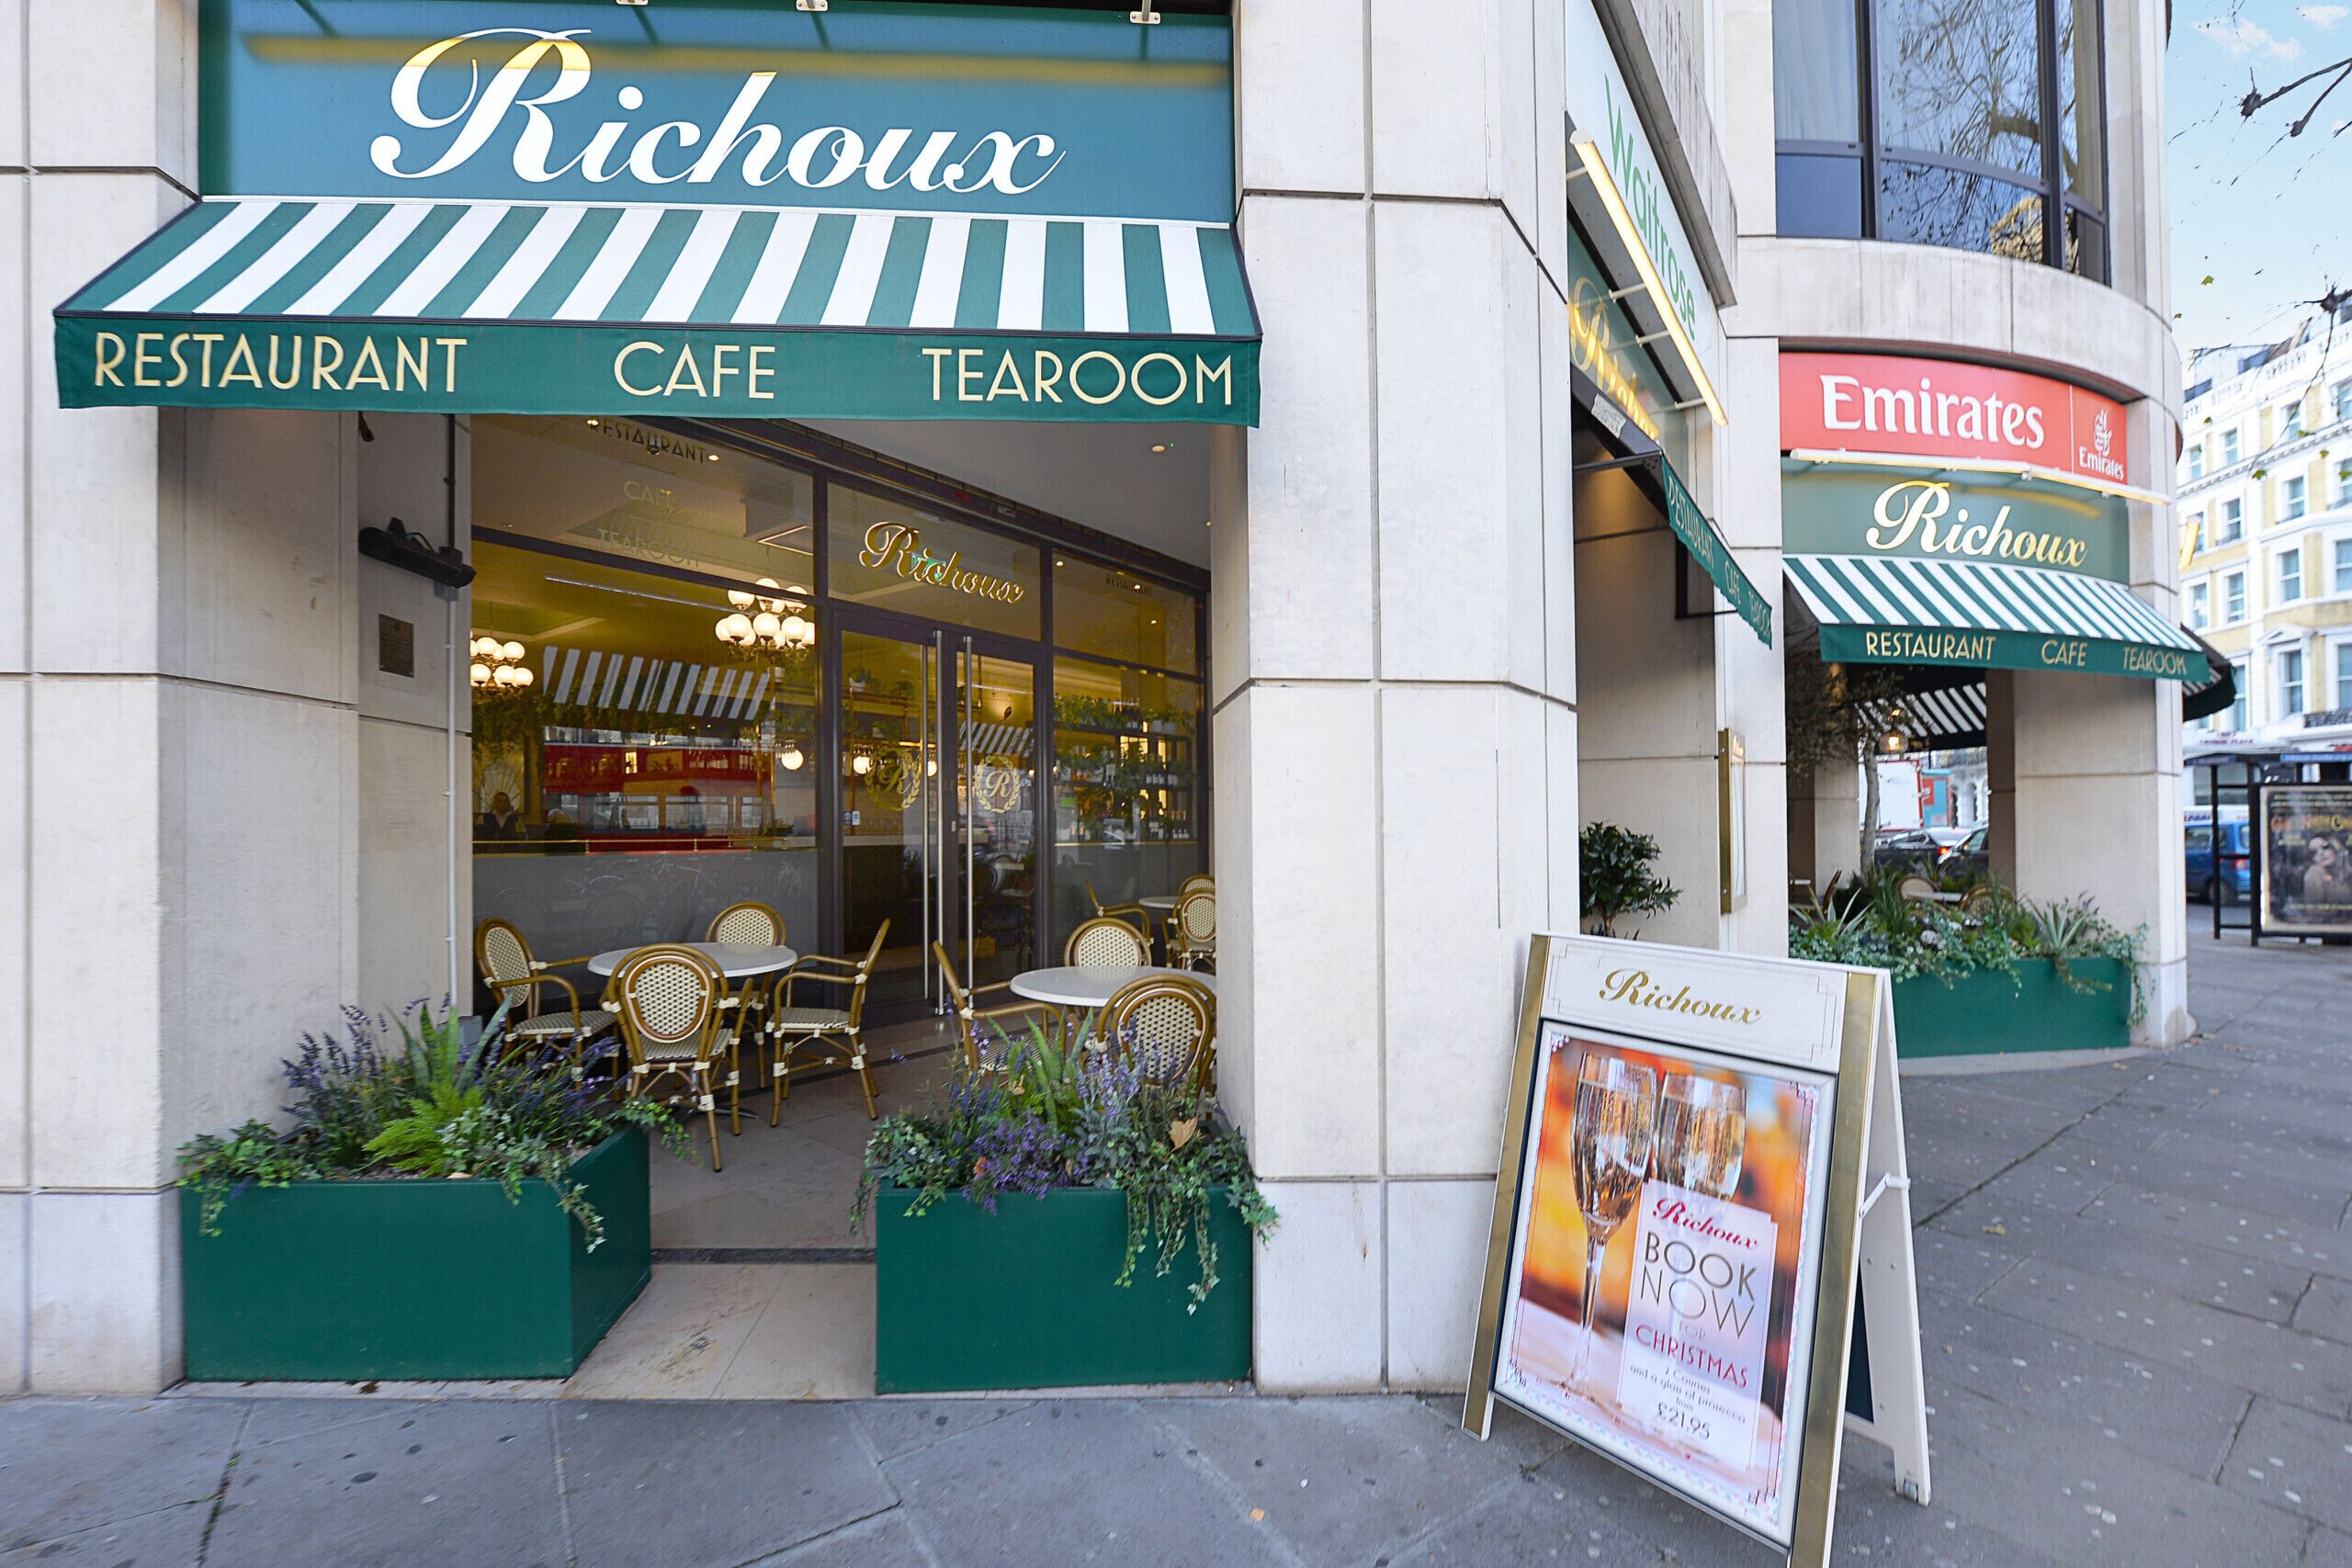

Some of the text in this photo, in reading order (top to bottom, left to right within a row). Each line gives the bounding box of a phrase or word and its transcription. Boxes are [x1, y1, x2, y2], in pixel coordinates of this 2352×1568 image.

[370, 28, 1066, 195] Richoux
[1603, 73, 1697, 342] Waitrose
[95, 332, 1232, 406] RESTAURANT CAFE TEAROOM
[589, 417, 707, 464] RESTAURANT
[1820, 375, 2044, 448] Emirates
[2078, 446, 2125, 480] Emirates
[623, 480, 677, 505] CAFE
[1668, 475, 1715, 570] RESTAURANT
[1724, 559, 1742, 605] CAFE
[1865, 480, 2087, 568] Richoux
[858, 521, 1024, 604] Richoux
[1866, 631, 2188, 675] RESTAURANT CAFE TEAROOM
[876, 763, 912, 795] R
[983, 770, 1012, 798] R
[1599, 967, 1762, 1025] Richoux
[1652, 1198, 1759, 1249] Richoux
[1645, 1231, 1757, 1302] BOOK
[1640, 1264, 1755, 1338] NOW
[1679, 1320, 1706, 1340] FOR
[1635, 1324, 1748, 1388] CHRISTMAS
[1630, 1365, 1648, 1378] and
[1660, 1379, 1682, 1395] glass
[1685, 1389, 1696, 1400] of
[1698, 1395, 1746, 1424] prosecco
[1657, 1401, 1710, 1440] £21.95
[1676, 1396, 1694, 1412] from
